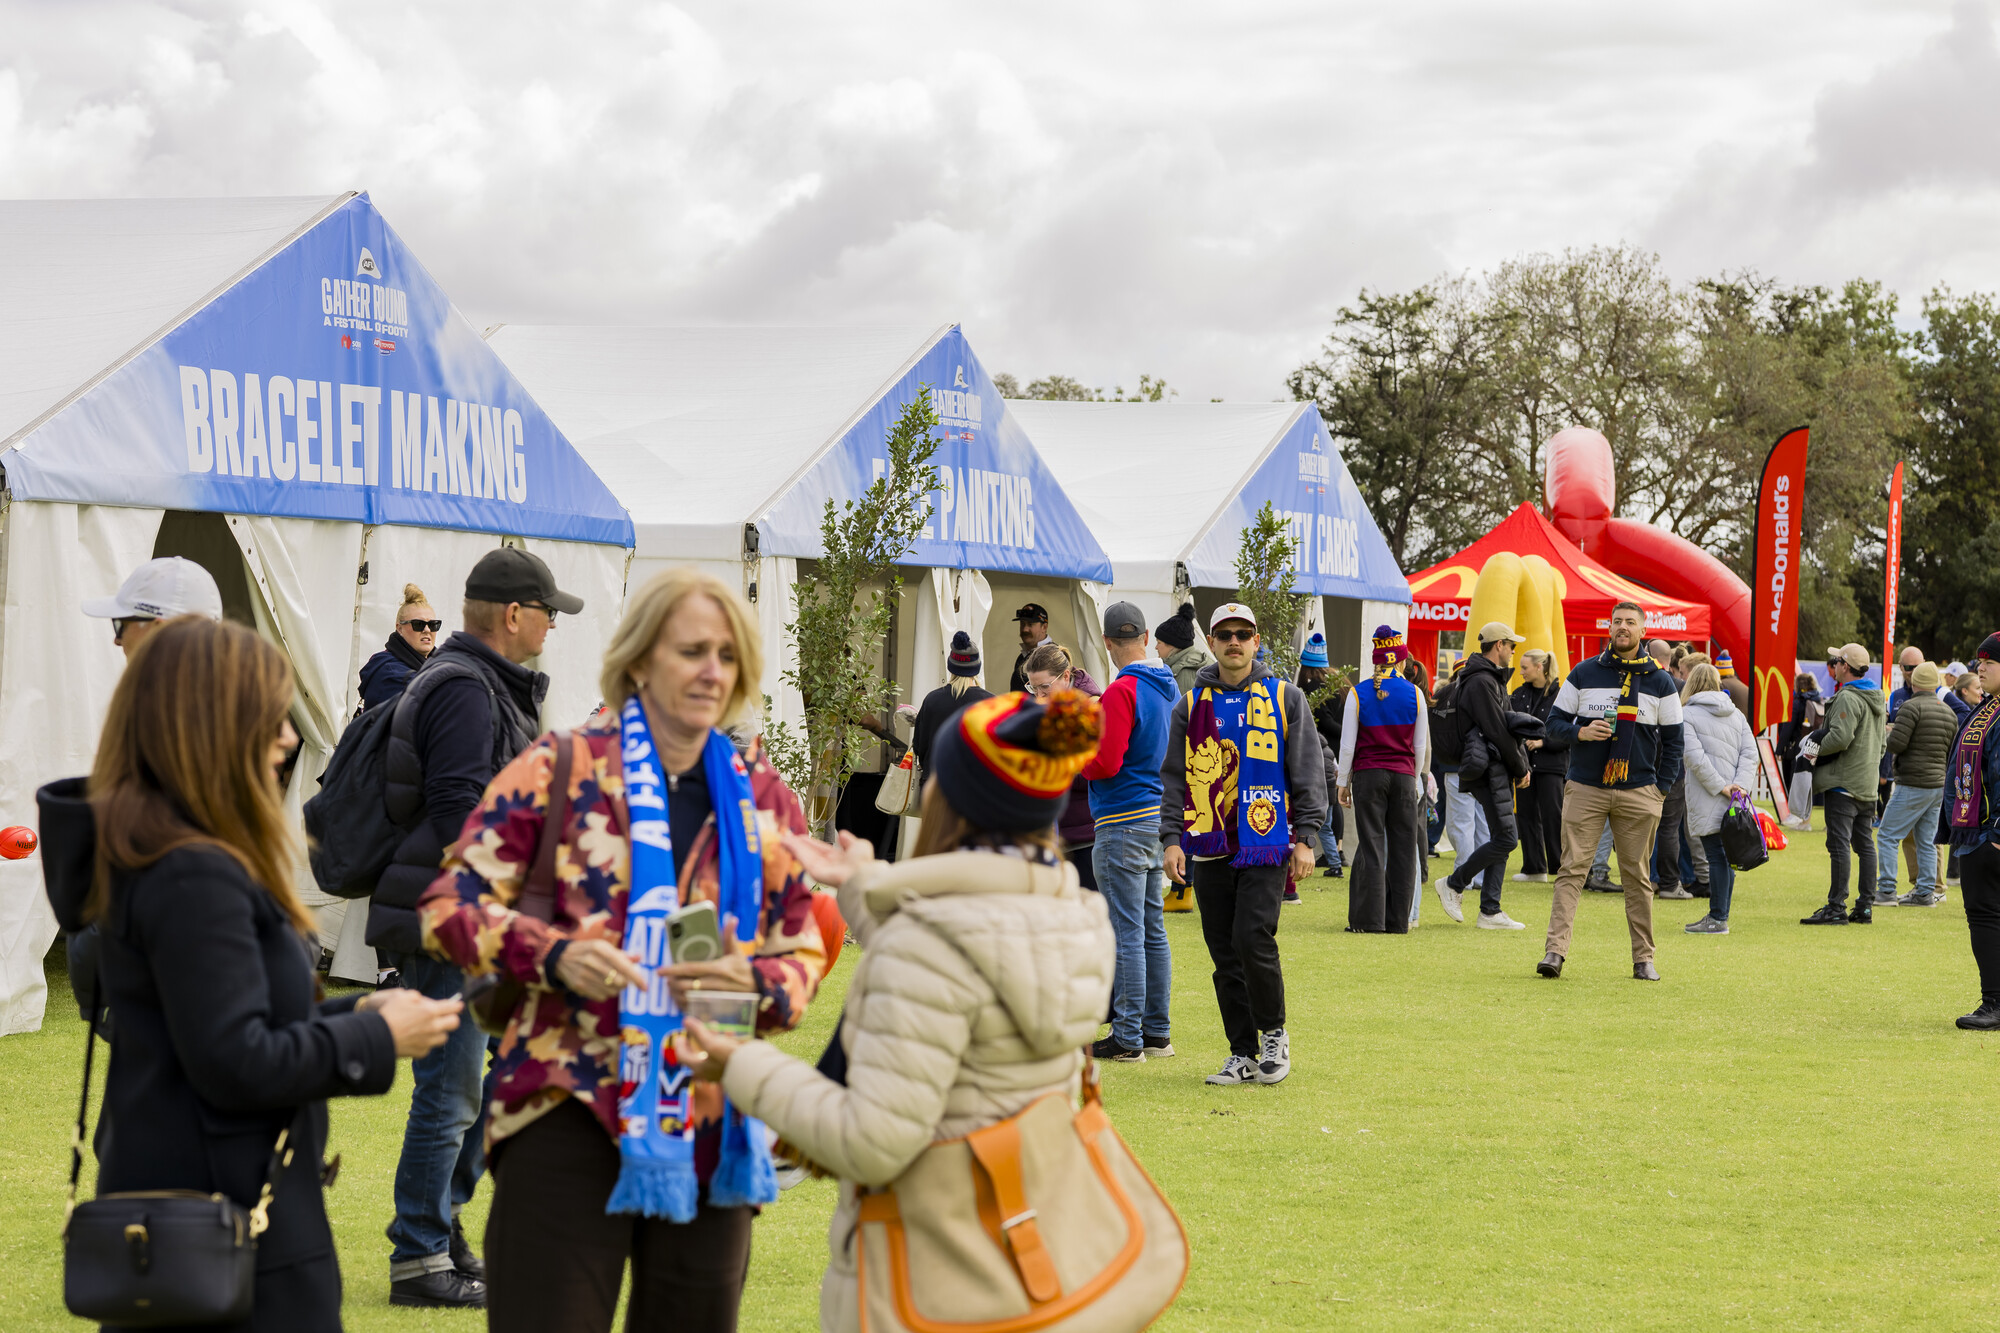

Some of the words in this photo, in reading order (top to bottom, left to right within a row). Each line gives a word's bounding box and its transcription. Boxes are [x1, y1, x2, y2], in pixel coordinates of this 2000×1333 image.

[321, 277, 371, 319] GATHER
[373, 284, 408, 326] ROUND
[323, 315, 332, 327] A
[333, 316, 373, 331] FESTIVAL
[179, 365, 381, 486] BRACELET
[390, 389, 527, 504] MAKING
[940, 464, 1035, 550] PAINTING
[1317, 513, 1359, 579] CARDS
[1770, 475, 1790, 635] McDonald's
[1385, 652, 1397, 664] B
[1242, 790, 1281, 803] LIONS
